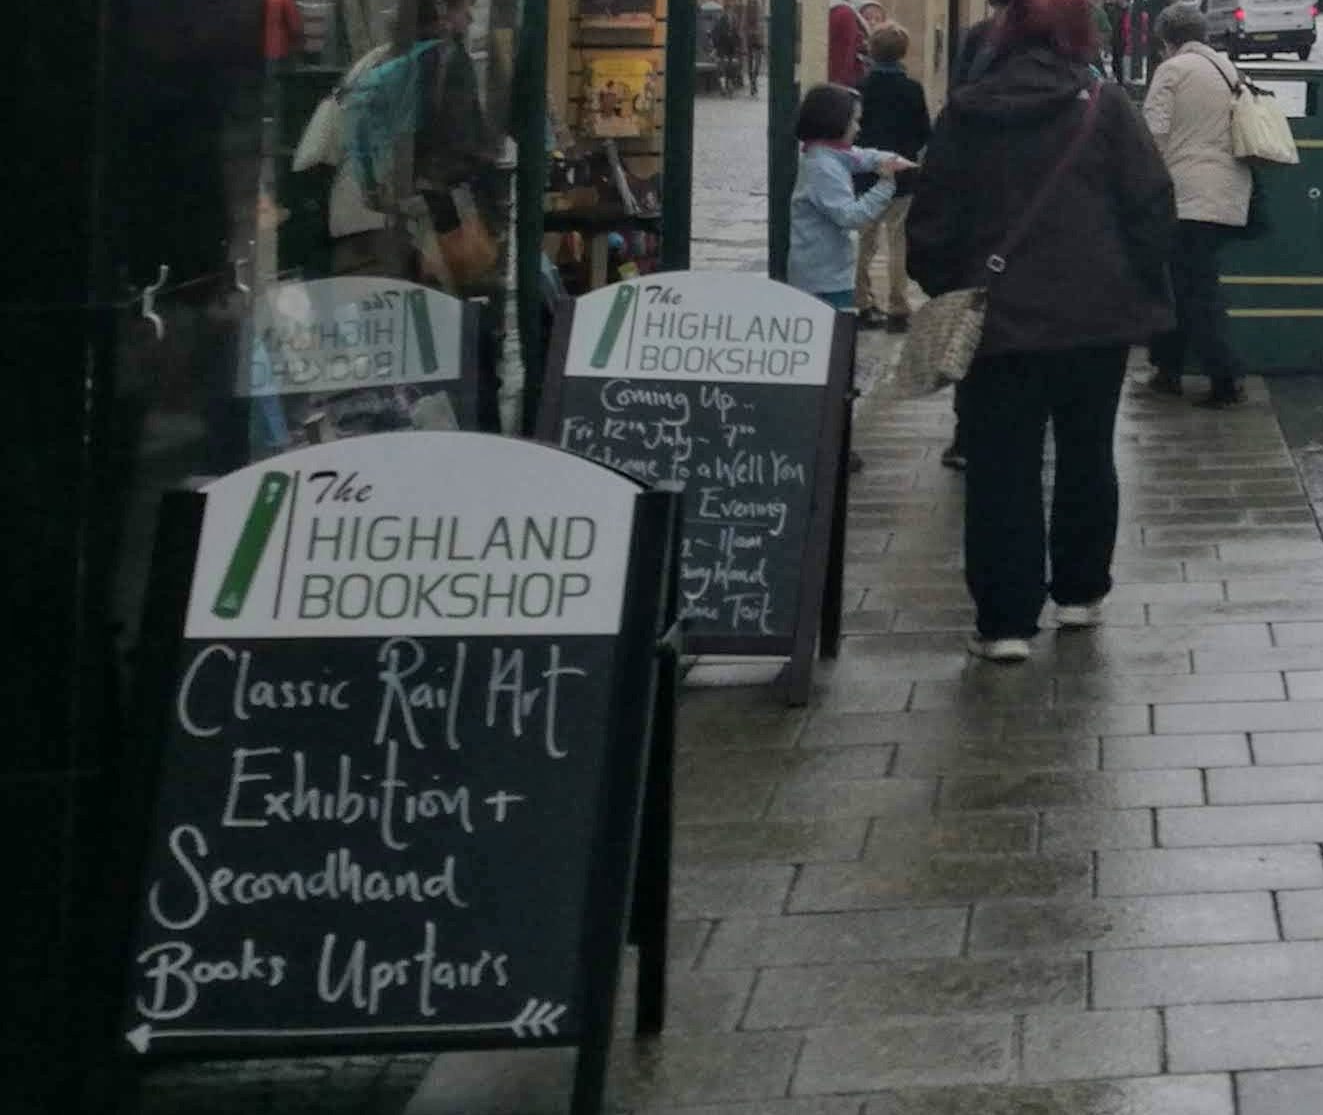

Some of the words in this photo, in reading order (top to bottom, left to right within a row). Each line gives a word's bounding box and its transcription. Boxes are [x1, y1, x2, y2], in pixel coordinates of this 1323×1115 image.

[645, 285, 683, 306] The
[645, 311, 814, 345] HIGHLAND
[639, 344, 811, 377] BOOKSHOP
[600, 378, 691, 426] Coming
[308, 470, 374, 504] The
[699, 486, 788, 536] Evening
[305, 515, 597, 563] HIGHLAND
[298, 572, 592, 620] BOOKSHOP
[177, 643, 351, 737] Classic
[373, 636, 467, 751] Rail
[485, 642, 587, 759] Art
[221, 739, 475, 851] Exhibition
[149, 824, 469, 930] Secondhand
[136, 939, 287, 1020] Books
[317, 920, 510, 1017] Upstairs
